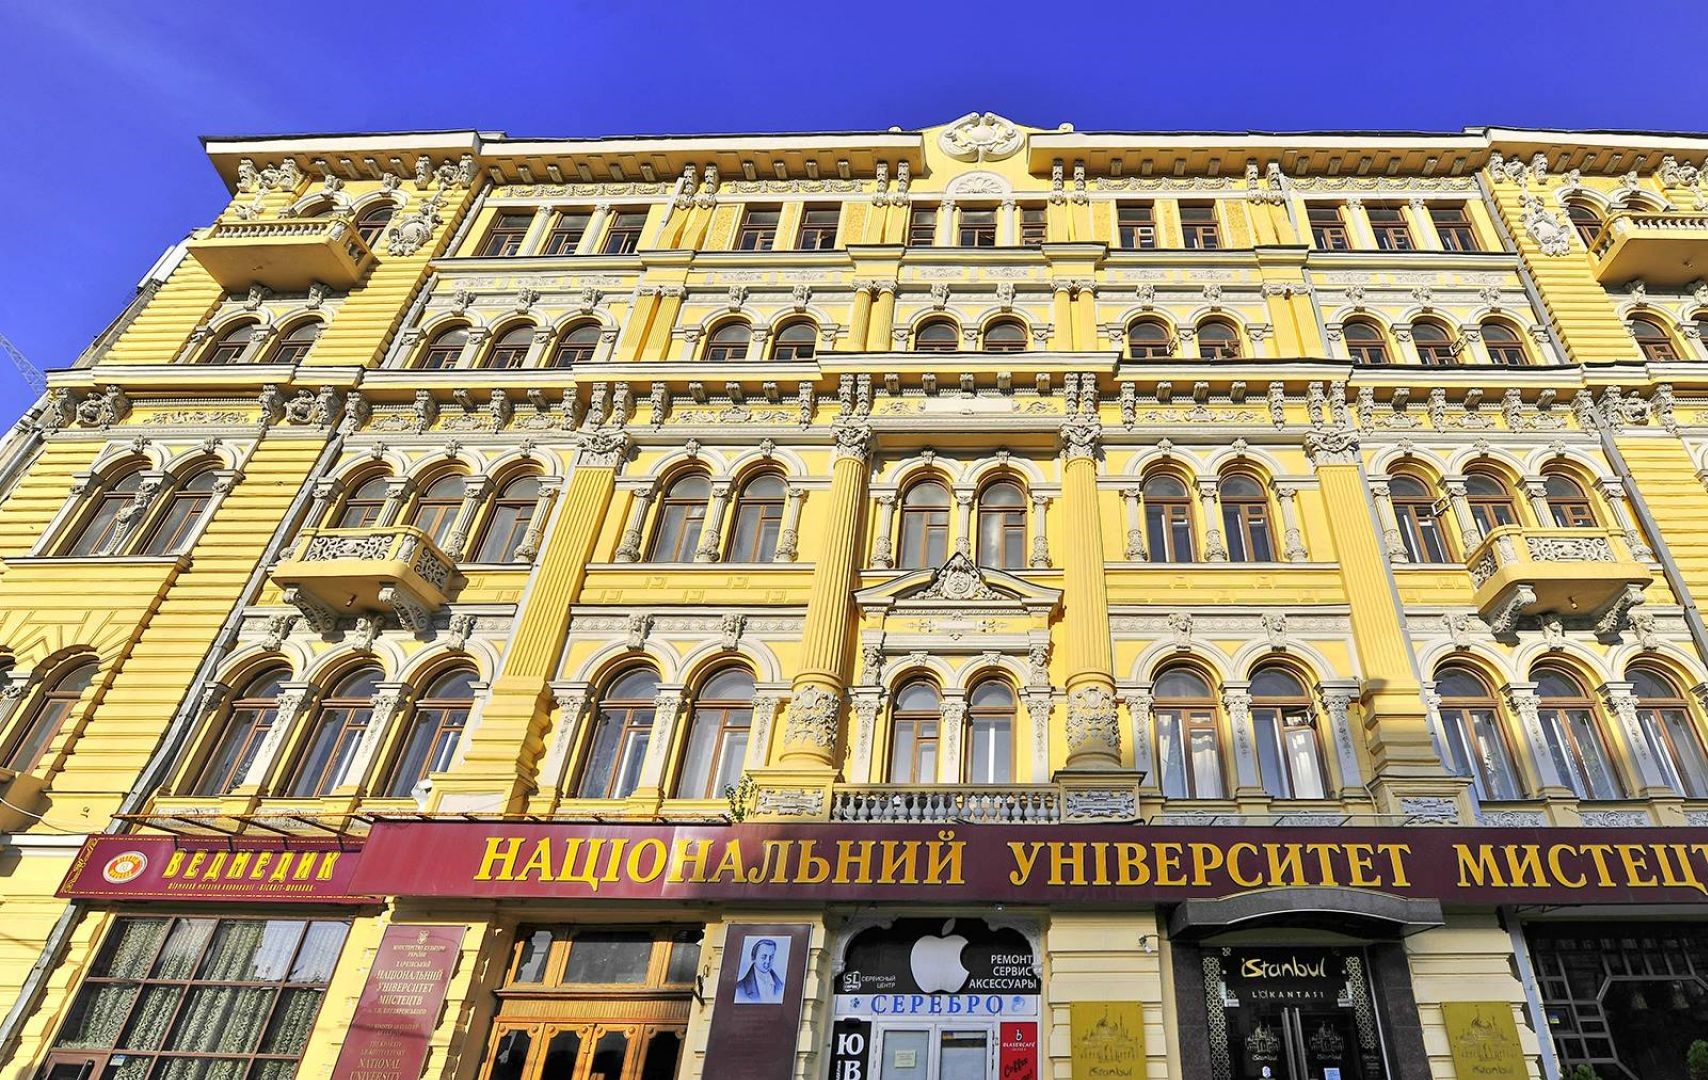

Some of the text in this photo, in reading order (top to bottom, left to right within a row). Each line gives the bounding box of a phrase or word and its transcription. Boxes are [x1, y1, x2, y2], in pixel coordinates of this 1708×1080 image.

[162, 848, 341, 883] ВЕДМЕДИК
[473, 829, 967, 891] НАЦІОНАЛЬНИЙ
[1007, 841, 1414, 887] УНІВЕРСИТЕТ
[991, 954, 1033, 965] РЕМОНТ
[376, 968, 444, 980] НАЦІОНАЛЬНИЙ
[993, 966, 1032, 976] СЕРВИС
[376, 982, 435, 992] УНІВЕРСИТЕТ
[969, 979, 1037, 989] АКСЕССУАРЫ
[378, 994, 424, 1005] МИСТЕЦТВ
[871, 995, 1004, 1014] СЕРЕБРО
[358, 1058, 401, 1069] NATIONAL
